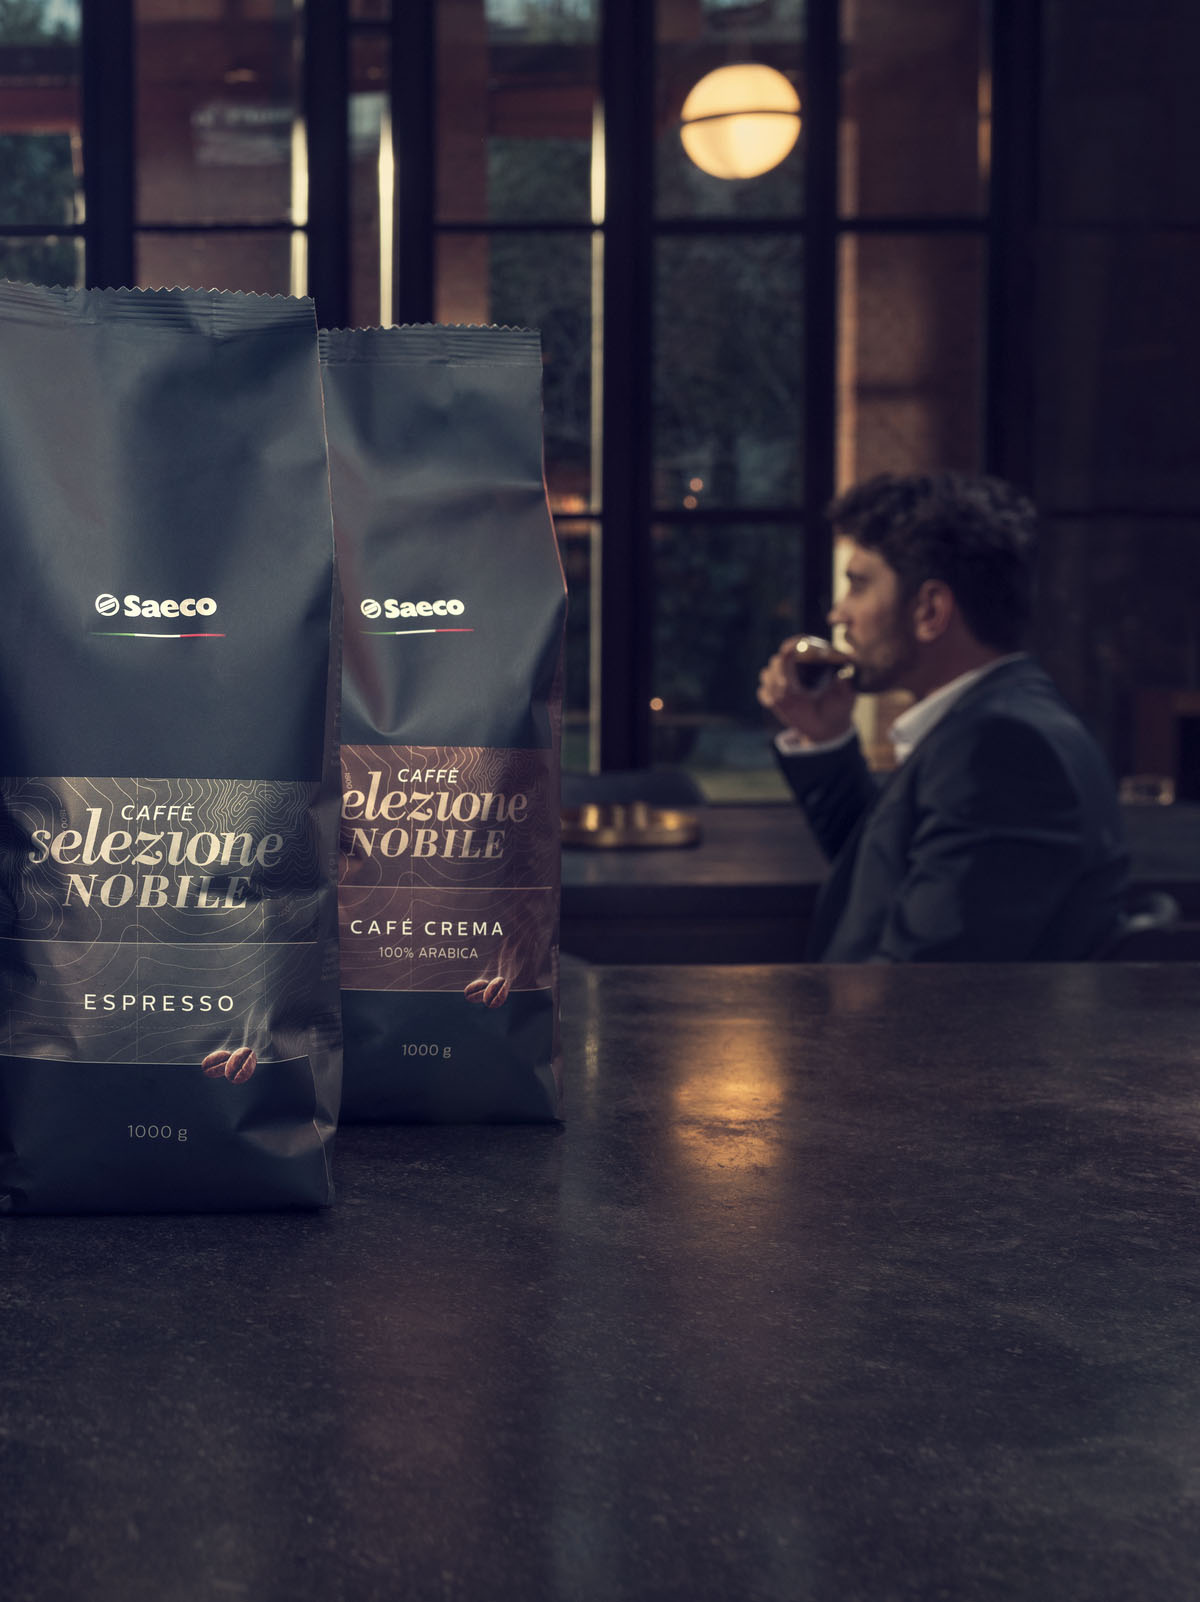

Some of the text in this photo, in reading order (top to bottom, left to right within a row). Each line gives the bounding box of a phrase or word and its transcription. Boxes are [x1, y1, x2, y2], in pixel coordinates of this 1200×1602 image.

[123, 594, 218, 618] Saeco
[384, 598, 465, 618] Saeco
[397, 767, 459, 784] CAFFÈ
[341, 771, 528, 824] elezione
[120, 802, 195, 822] CAFFÈ
[28, 808, 284, 868] selezione
[347, 827, 507, 859] NOBILE
[62, 873, 252, 909] NOBILE
[350, 918, 504, 937] CAFÉ CREMA
[379, 946, 479, 959] 100% ARABICA
[83, 993, 235, 1012] ESPRESSO
[402, 1044, 452, 1059] 1000 g
[127, 1124, 188, 1142] 1000 g
